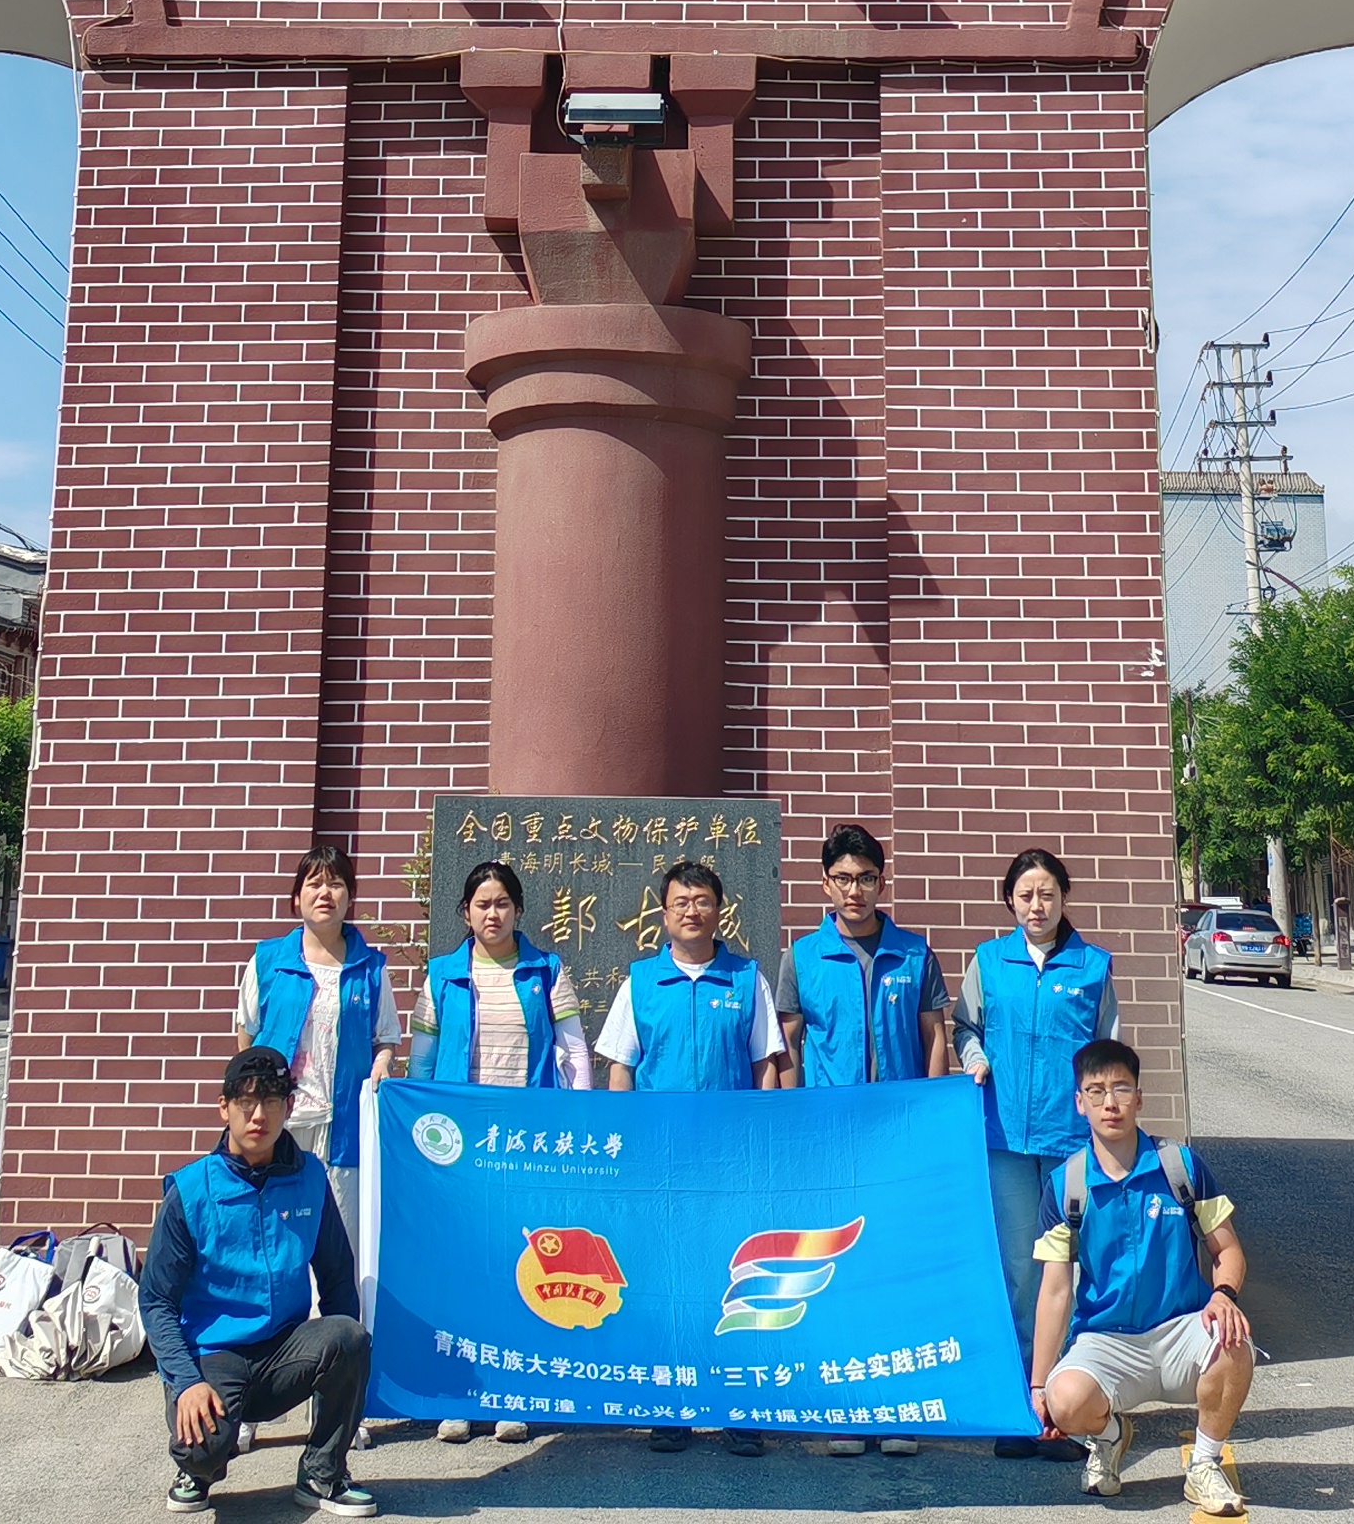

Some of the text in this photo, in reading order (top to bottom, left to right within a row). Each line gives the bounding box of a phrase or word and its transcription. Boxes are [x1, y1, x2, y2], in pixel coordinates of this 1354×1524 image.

[456, 809, 762, 850] 全国重点文物保护单位
[474, 1157, 620, 1177] Qinghai Minzu University
